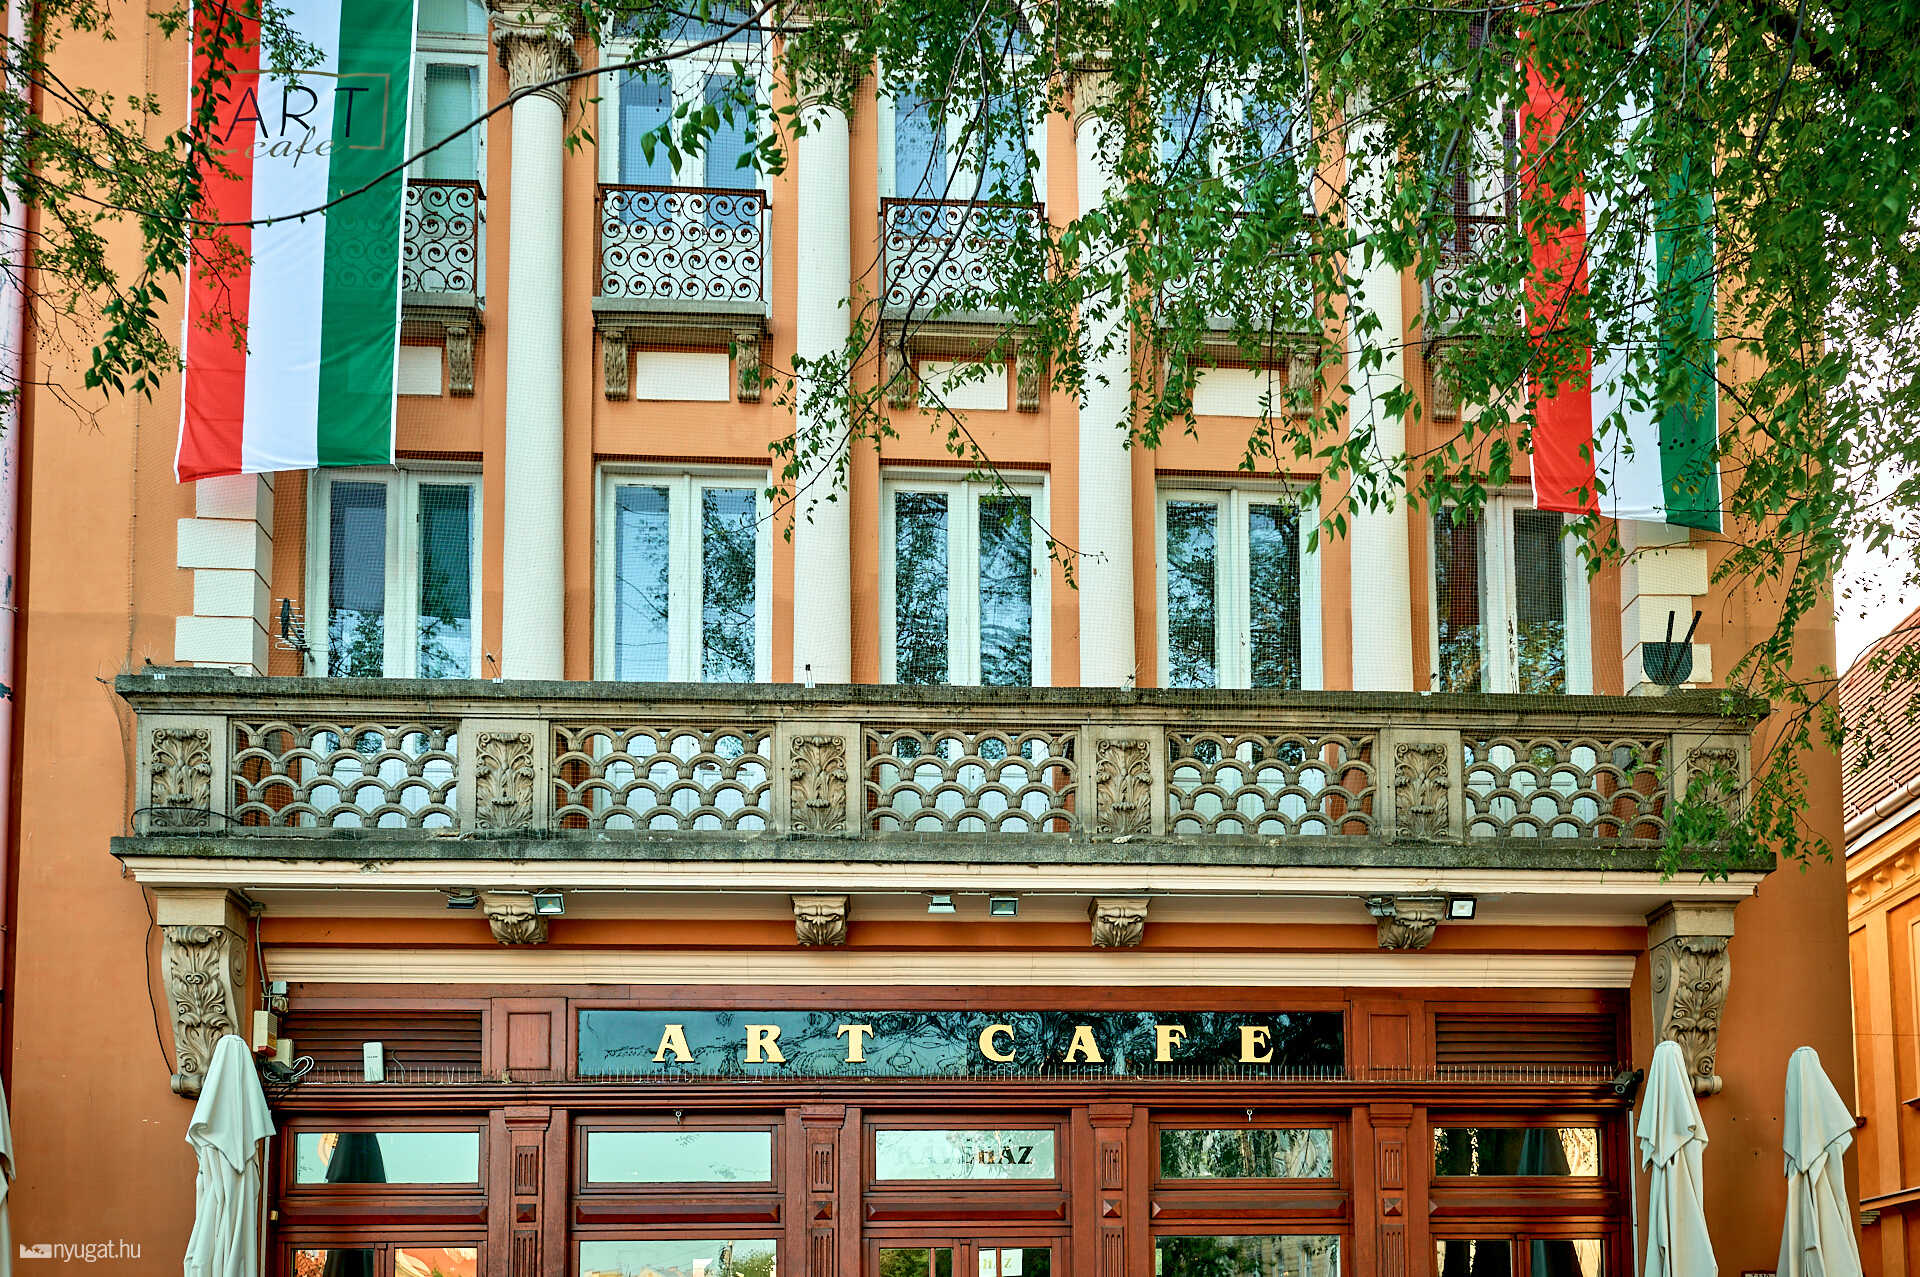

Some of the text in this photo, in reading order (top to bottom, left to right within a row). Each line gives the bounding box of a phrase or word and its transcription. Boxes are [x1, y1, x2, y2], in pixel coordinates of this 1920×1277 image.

[224, 85, 369, 142] ART
[244, 126, 342, 168] cafe
[652, 1024, 1274, 1063] ART CAFE
